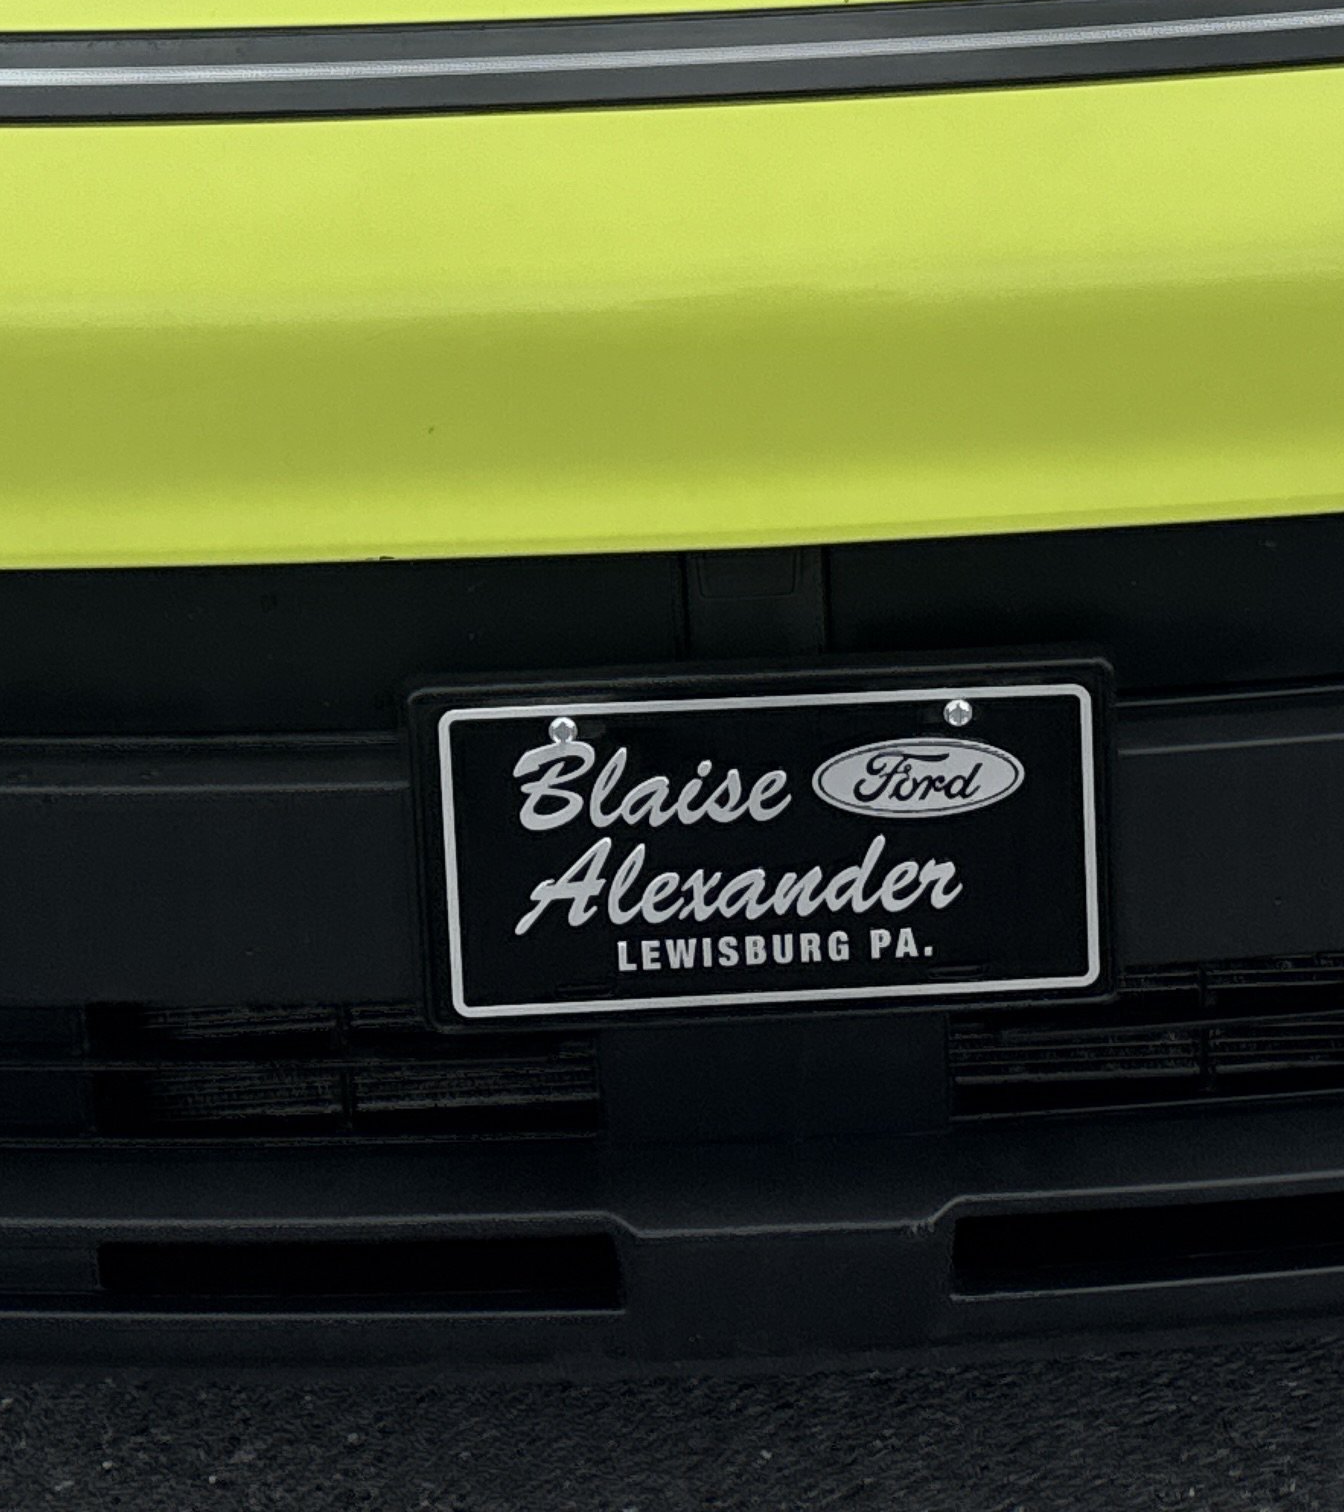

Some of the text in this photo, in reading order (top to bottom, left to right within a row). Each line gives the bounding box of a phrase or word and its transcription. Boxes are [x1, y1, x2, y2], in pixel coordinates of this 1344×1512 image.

[512, 739, 793, 831] Blaise
[854, 750, 984, 804] Ford
[514, 834, 963, 936] Alexander
[617, 927, 934, 972] LEWISBURG PA.
